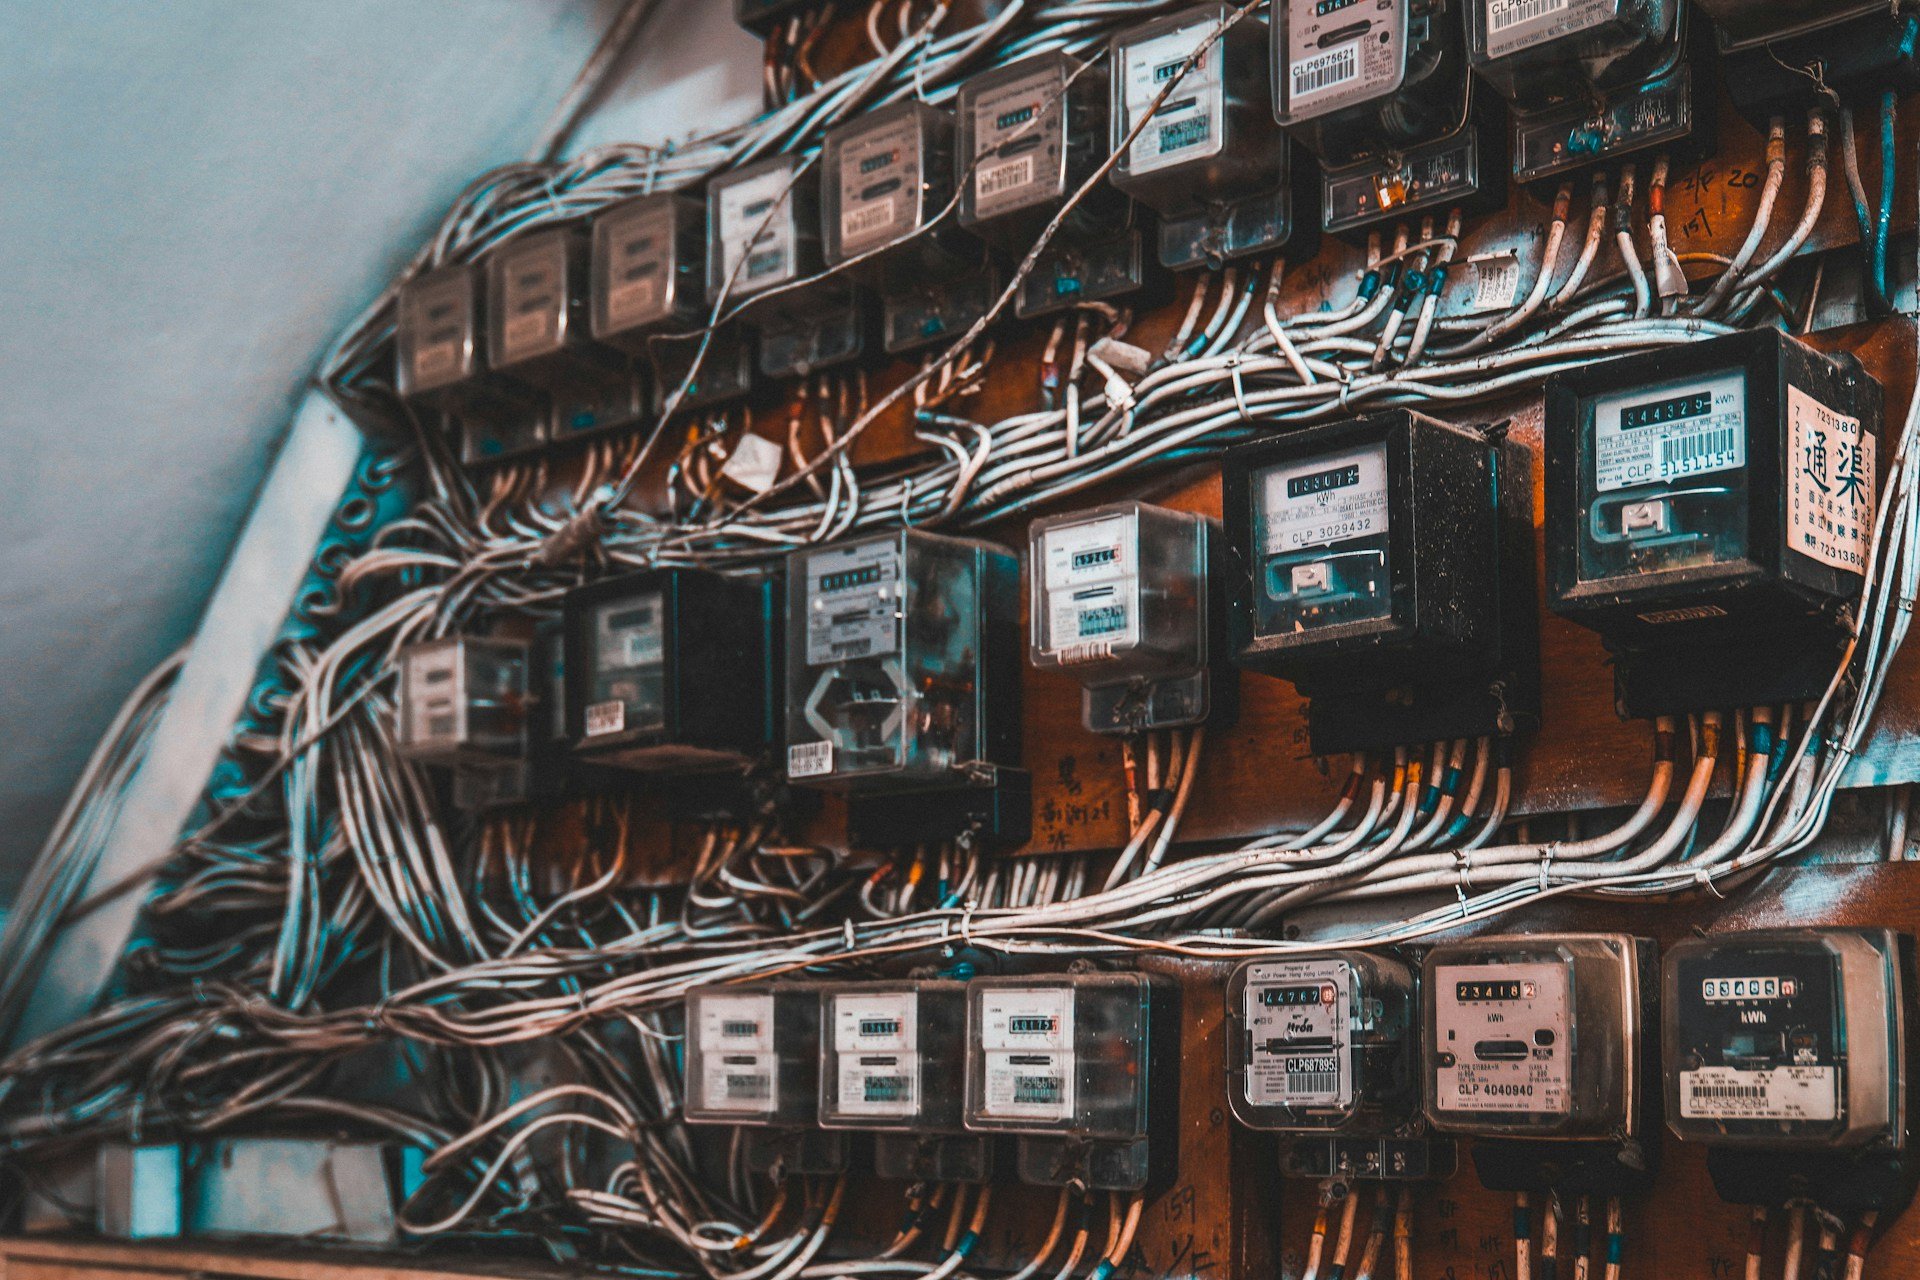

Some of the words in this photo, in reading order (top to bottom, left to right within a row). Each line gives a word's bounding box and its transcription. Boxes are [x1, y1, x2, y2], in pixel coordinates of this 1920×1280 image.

[1292, 48, 1355, 77] CLP6975621
[1727, 169, 1759, 188] 20
[1715, 394, 1735, 405] kWh
[1816, 407, 1857, 434] 7231380
[1627, 463, 1652, 479] CLP
[1660, 451, 1735, 477] 3151154
[1316, 490, 1336, 504] kWh
[1292, 531, 1313, 544] CLP
[1319, 518, 1371, 539] 3029432
[1487, 1013, 1504, 1023] kWh
[1740, 1011, 1767, 1023] kWh
[1458, 1084, 1479, 1096] CLP
[1484, 1084, 1533, 1096] 4040940
